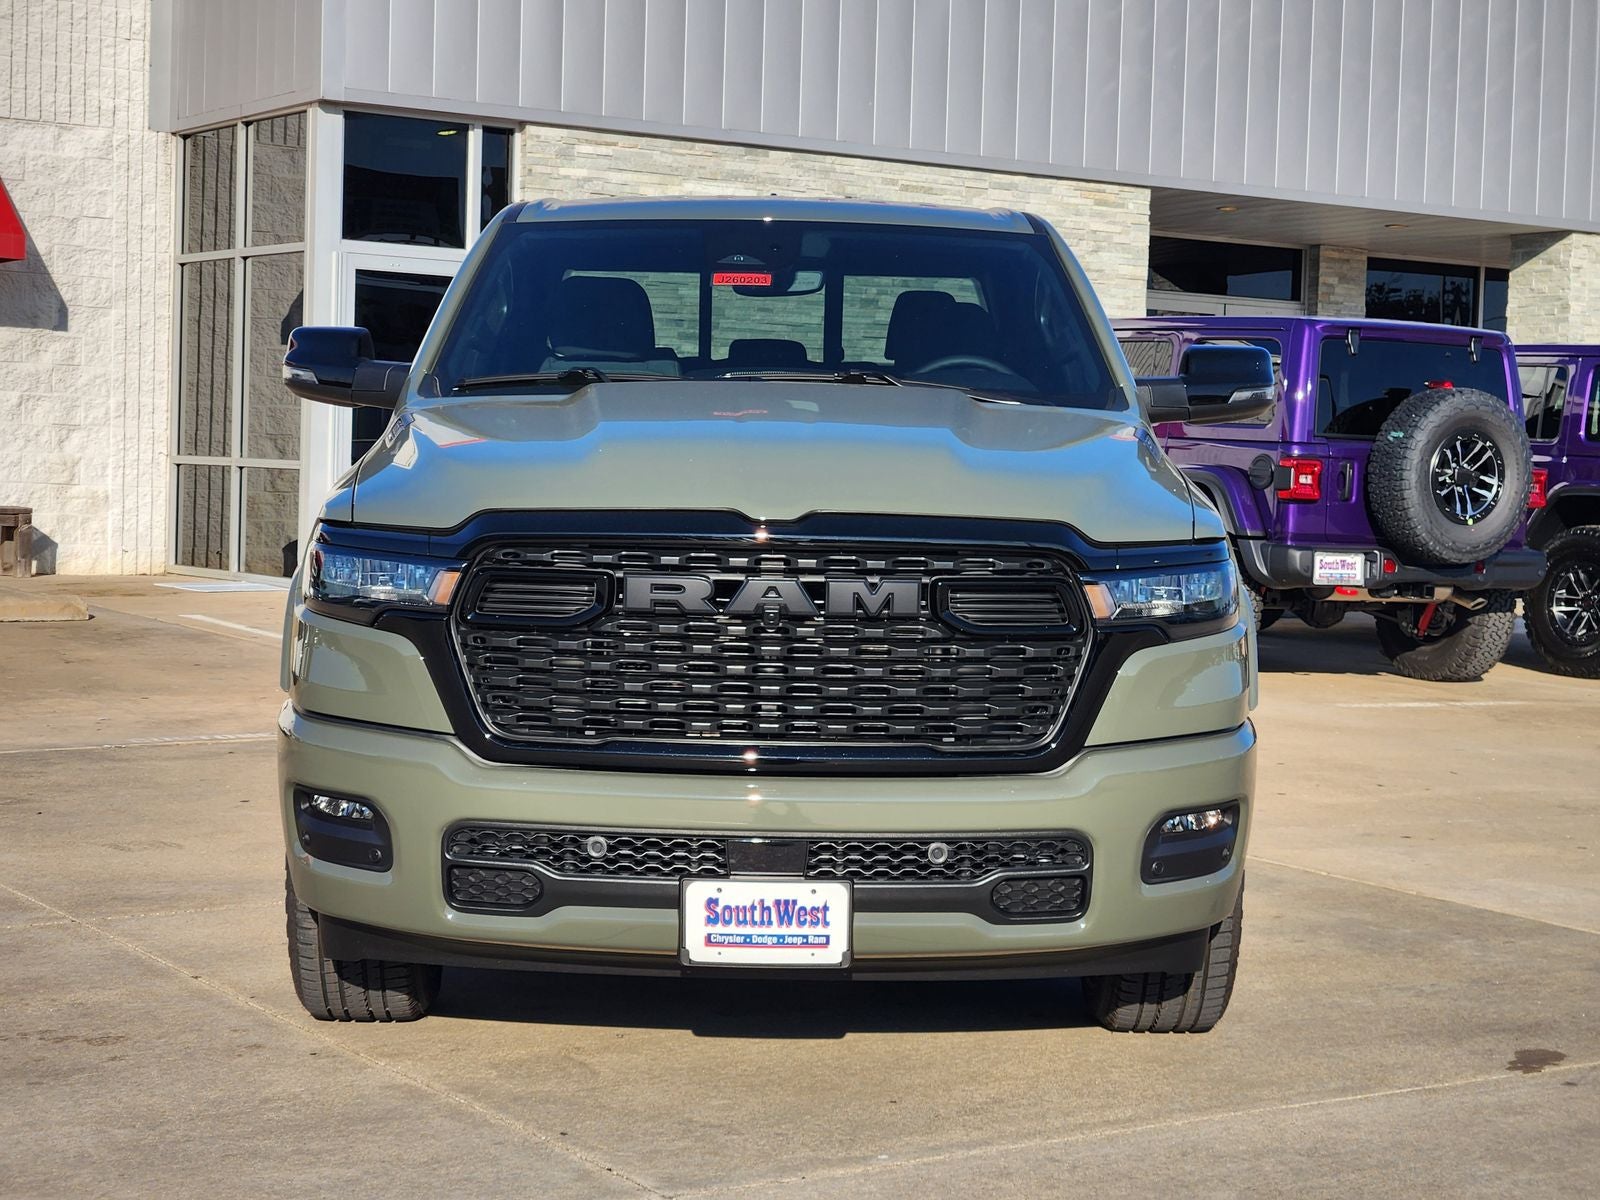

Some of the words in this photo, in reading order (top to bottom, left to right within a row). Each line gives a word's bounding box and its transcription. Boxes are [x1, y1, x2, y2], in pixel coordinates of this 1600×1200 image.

[718, 276, 767, 284] J260203
[622, 574, 922, 616] RAM
[704, 897, 830, 928] SouthWest
[711, 934, 744, 945] Chrysler
[752, 935, 777, 945] Dodge
[784, 935, 803, 945] Jeep
[808, 936, 826, 945] Ram
